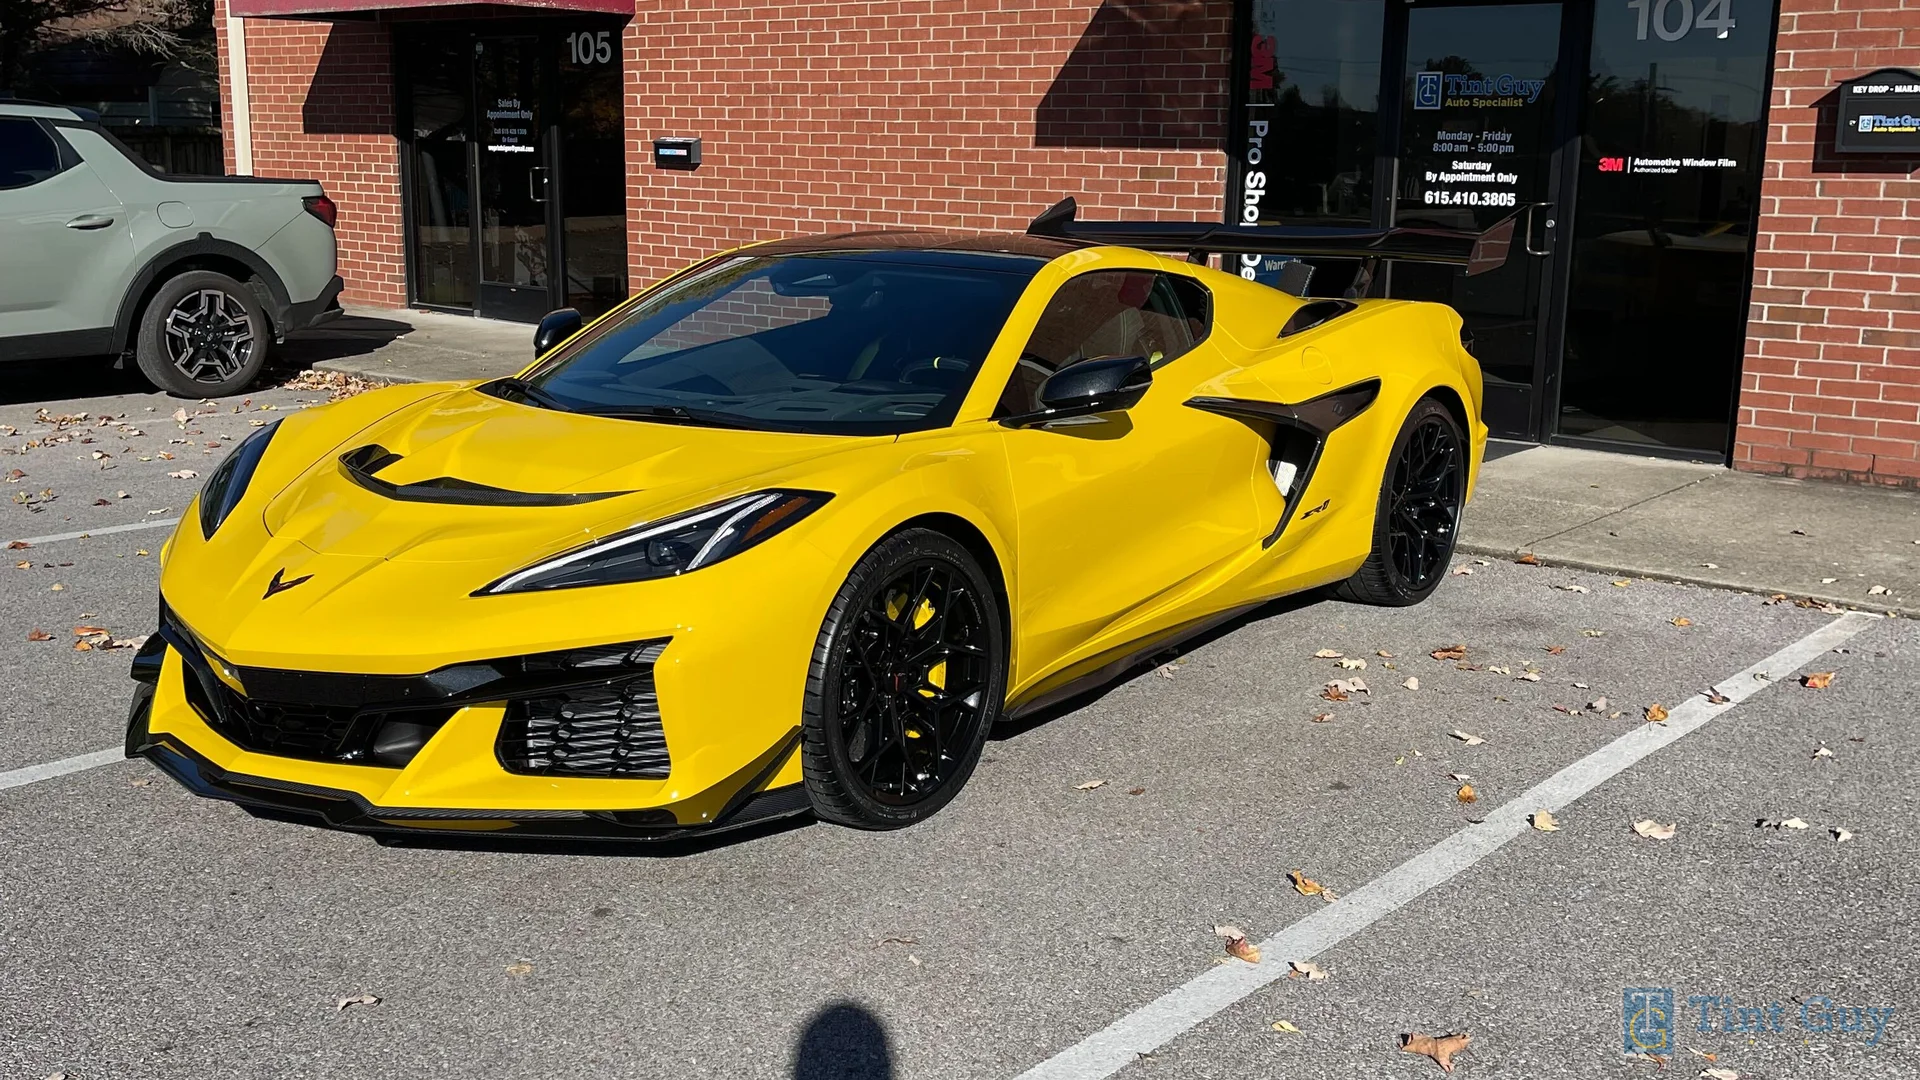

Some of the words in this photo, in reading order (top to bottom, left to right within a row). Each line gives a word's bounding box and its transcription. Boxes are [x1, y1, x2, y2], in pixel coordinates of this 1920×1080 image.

[1627, 0, 1735, 41] 104
[566, 31, 612, 64] 105
[1250, 35, 1277, 89] 3M
[1445, 74, 1494, 95] Tint
[1496, 73, 1545, 103] Guy
[1895, 85, 1920, 93] MAILB
[498, 98, 512, 108] Sales
[1445, 98, 1470, 107] Auto
[1472, 98, 1523, 108] Specialist
[487, 110, 520, 120] Appointment
[521, 110, 533, 120] Only
[1874, 115, 1900, 126] Tint
[1901, 115, 1920, 127] Gu
[1248, 121, 1268, 164] Pro
[1437, 131, 1473, 142] Monday
[1482, 131, 1512, 142] Friday
[1452, 161, 1492, 172] Saturday
[1598, 158, 1624, 171] 3M
[1634, 158, 1680, 166] Automotive
[1682, 158, 1717, 167] Window
[1718, 159, 1737, 167] Film
[1426, 172, 1438, 183] By
[1439, 172, 1496, 183] Appointment
[1497, 173, 1518, 184] Only
[1240, 171, 1266, 226] Sho
[1424, 191, 1516, 206] 615.410.3805
